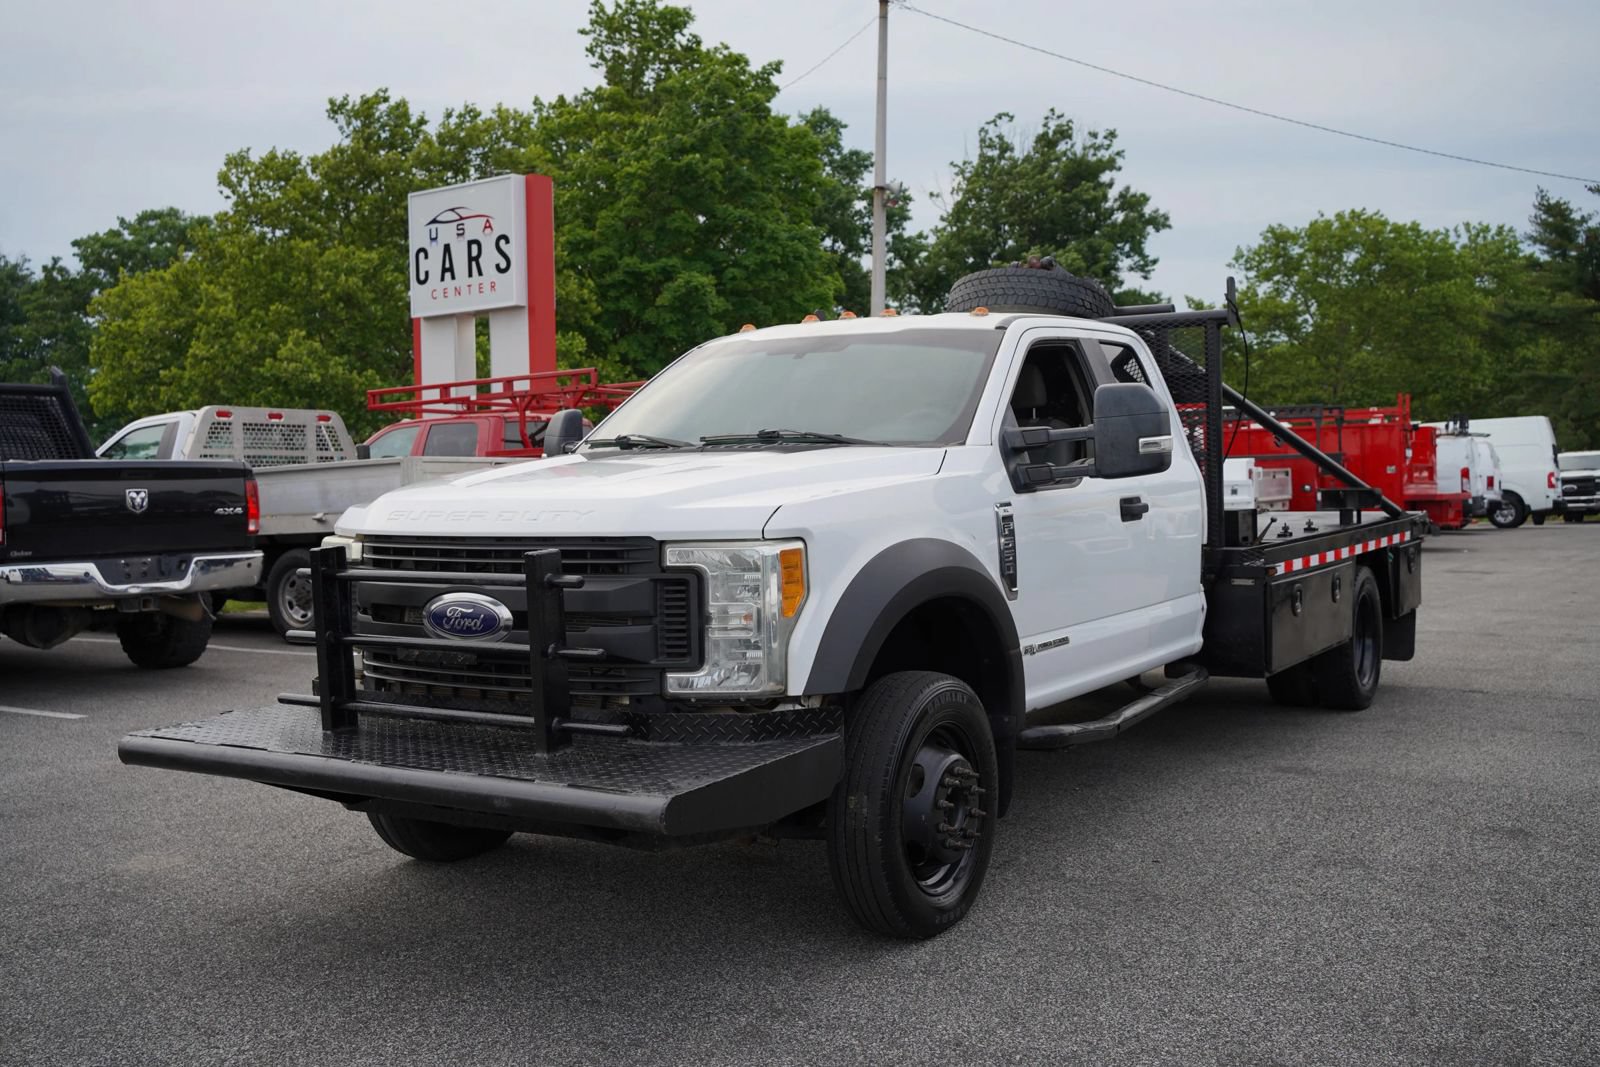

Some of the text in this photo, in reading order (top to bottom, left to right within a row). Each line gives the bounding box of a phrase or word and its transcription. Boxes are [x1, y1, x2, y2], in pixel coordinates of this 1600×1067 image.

[429, 218, 494, 241] USA
[415, 233, 512, 285] CARS
[431, 281, 496, 300] CENTER
[386, 509, 596, 522] SUPER DUTY
[442, 606, 485, 631] Ford
